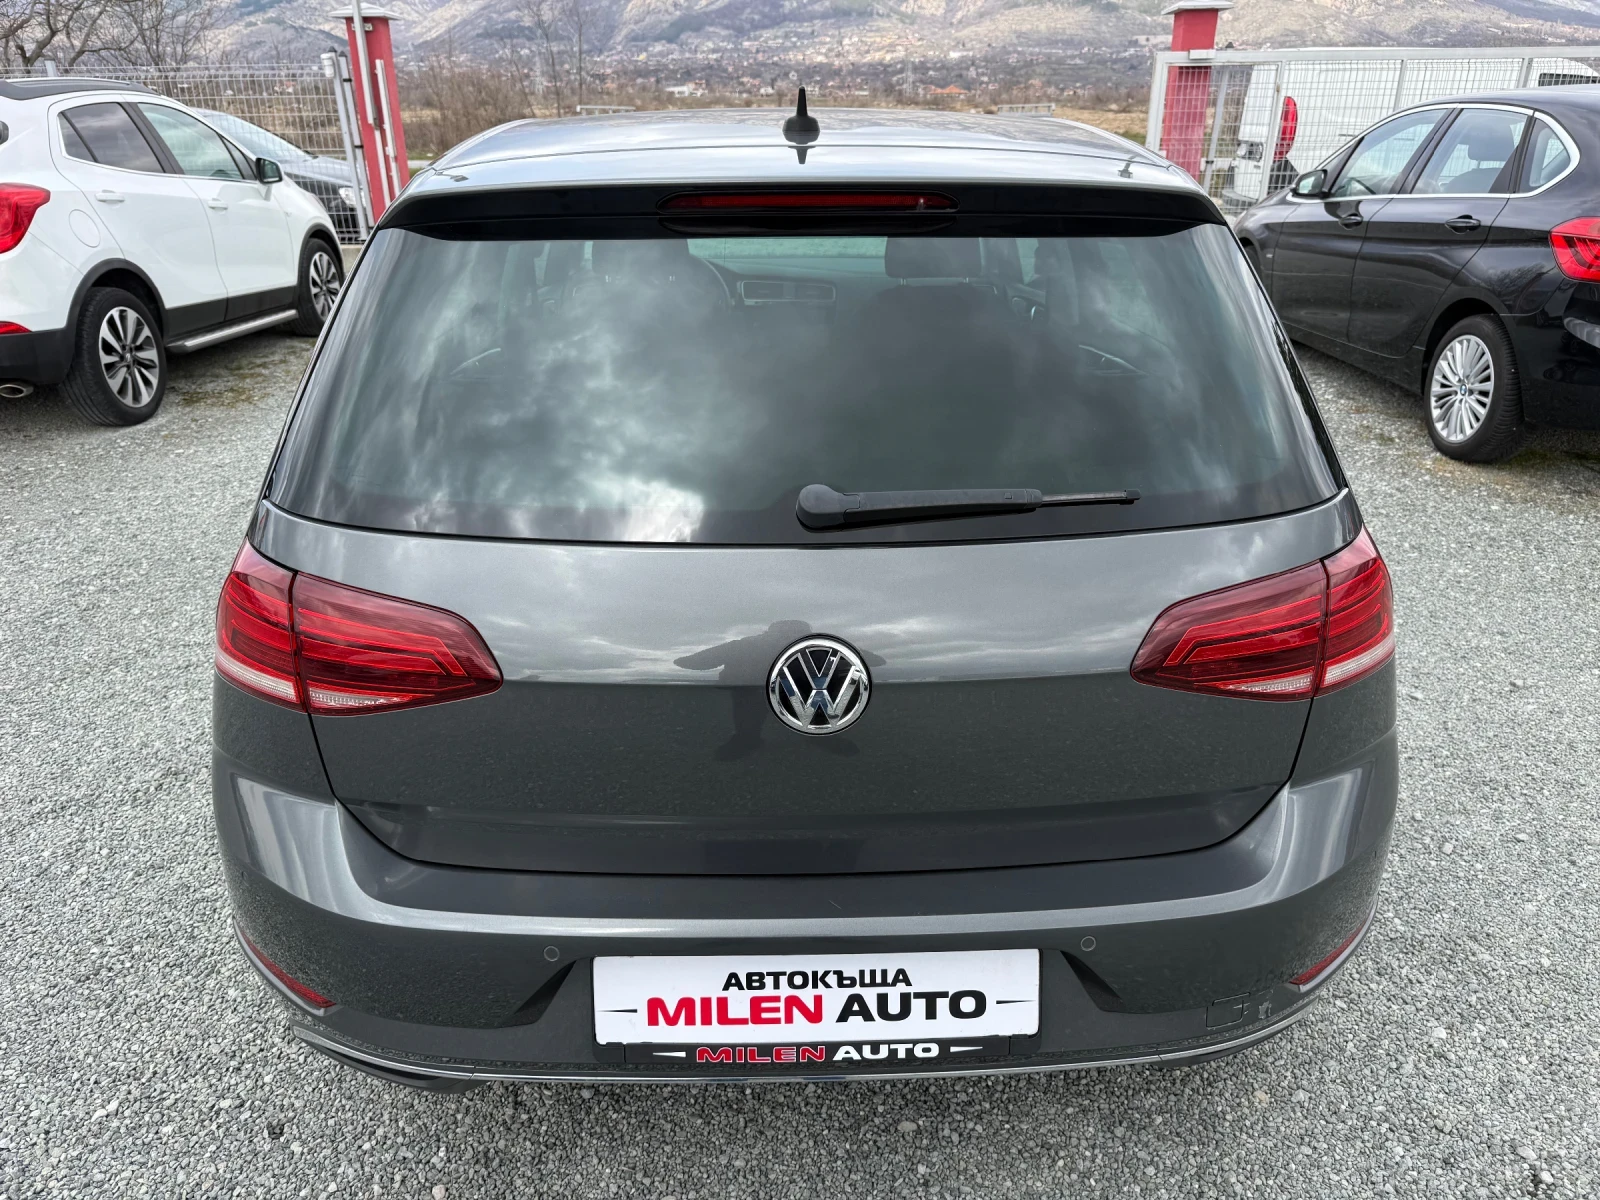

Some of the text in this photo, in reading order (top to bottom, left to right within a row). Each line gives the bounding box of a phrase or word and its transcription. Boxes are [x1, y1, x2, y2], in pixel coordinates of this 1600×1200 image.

[771, 640, 868, 732] VW
[647, 990, 987, 1026] MILEN AUTO
[696, 1043, 940, 1063] MILEN AUTO
